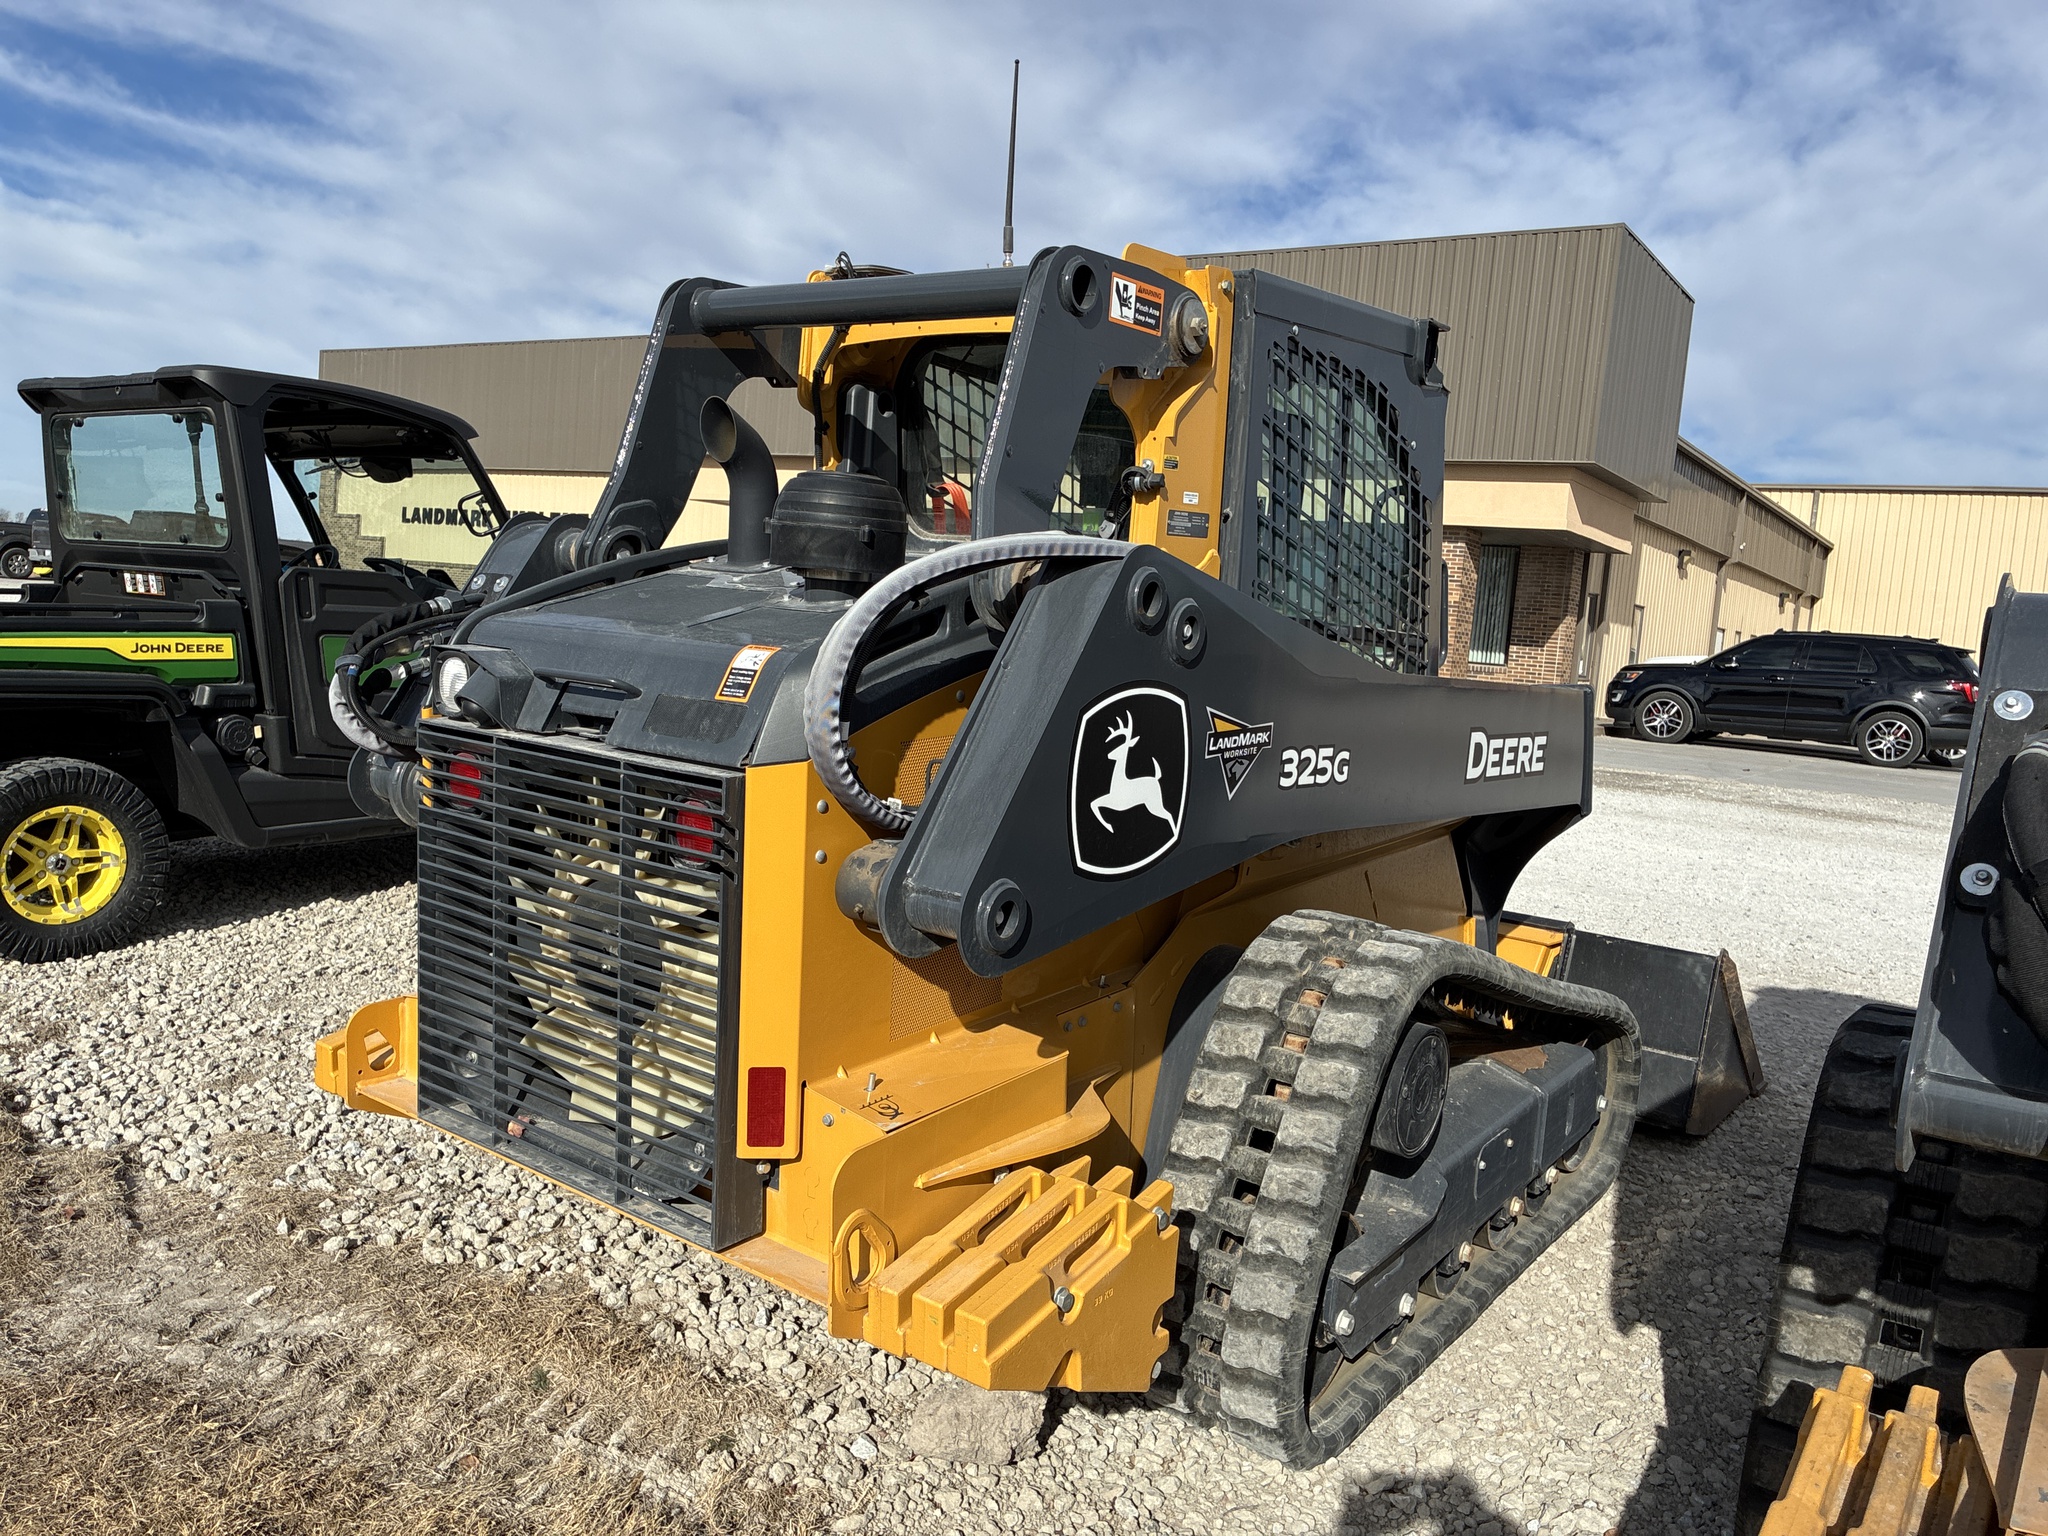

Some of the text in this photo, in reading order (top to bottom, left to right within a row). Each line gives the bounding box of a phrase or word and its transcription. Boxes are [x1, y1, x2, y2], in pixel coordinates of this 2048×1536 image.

[1141, 287, 1162, 300] WARNING
[1136, 302, 1160, 317] Pinch Area
[1135, 312, 1156, 326] Keep Away
[130, 642, 224, 653] JOHN DEERE
[1209, 731, 1270, 751] LANDMARK
[1223, 746, 1258, 759] WORKSITE
[1466, 731, 1547, 780] DEERE
[1280, 746, 1350, 788] 325G
